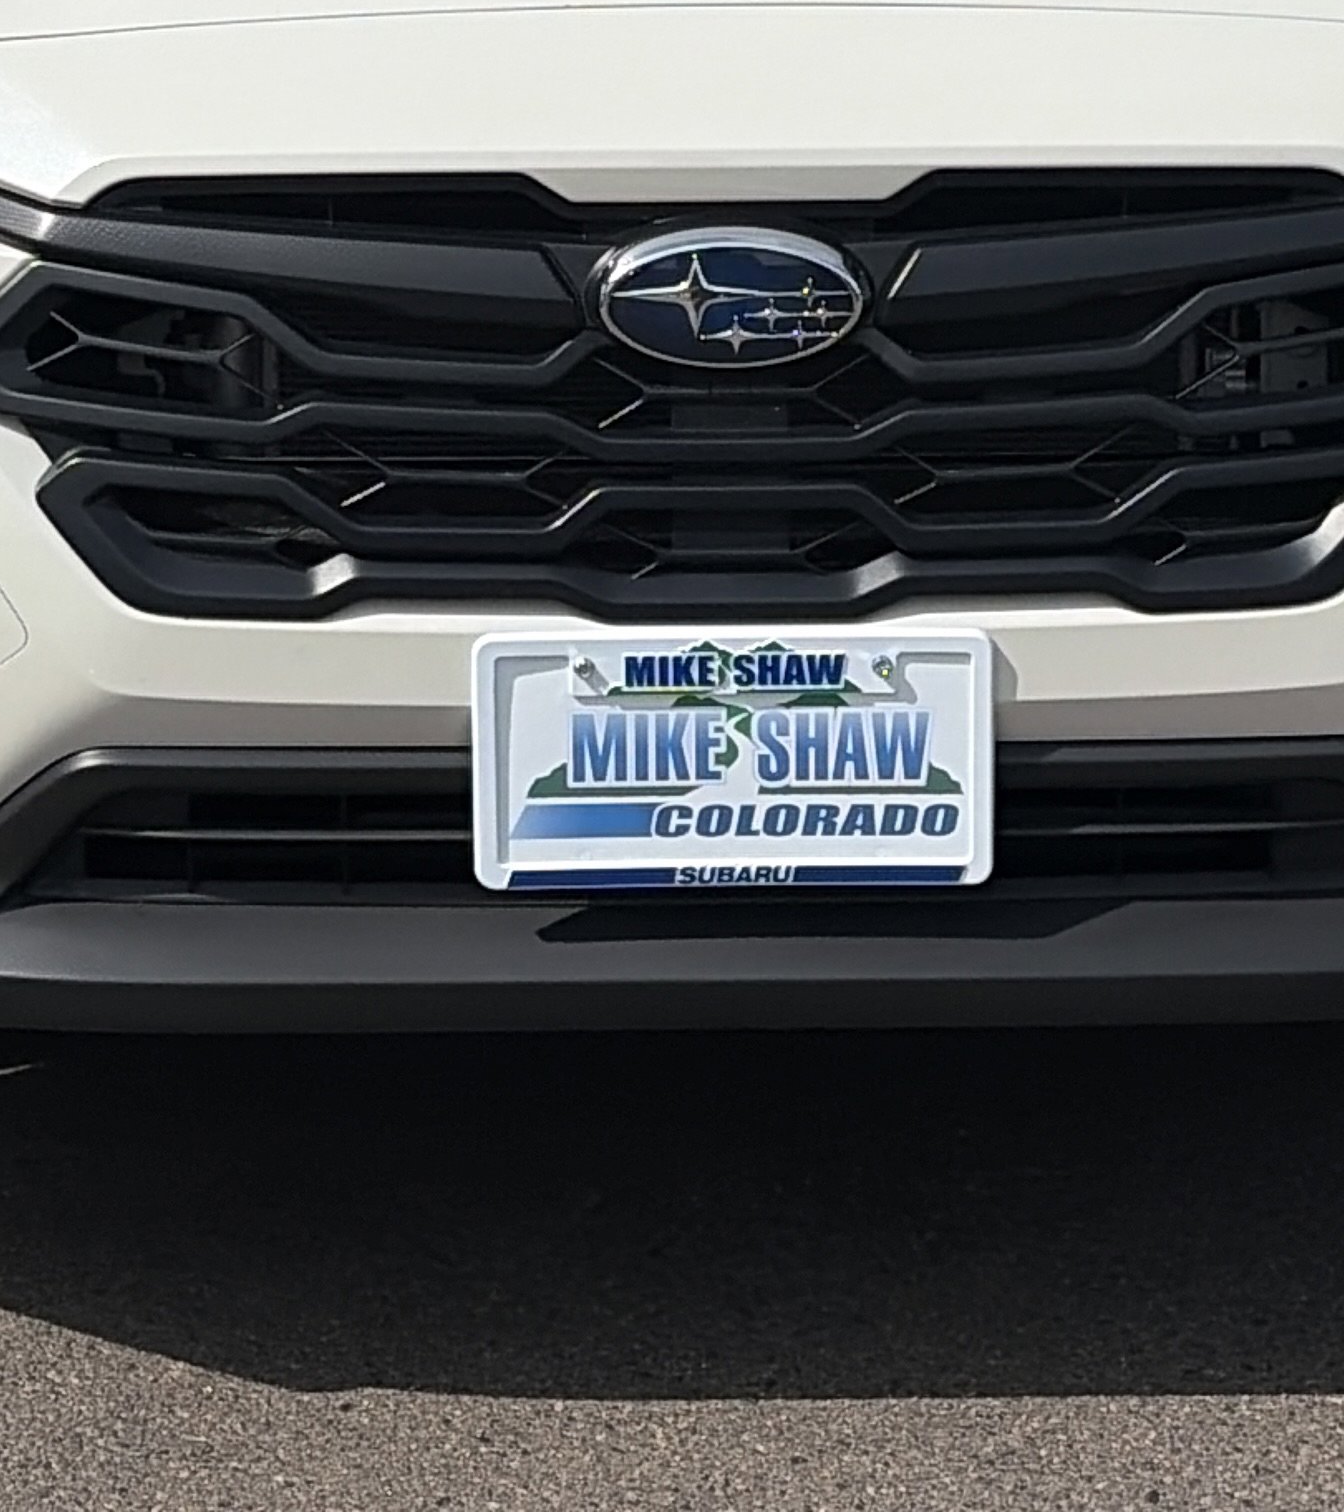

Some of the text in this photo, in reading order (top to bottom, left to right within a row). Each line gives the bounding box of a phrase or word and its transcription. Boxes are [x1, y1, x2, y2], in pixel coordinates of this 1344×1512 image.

[624, 653, 846, 687] MIKE SHAW
[571, 710, 929, 782] MIKE SHAW
[655, 803, 958, 837] COLORADO
[677, 866, 792, 884] SUBARU
